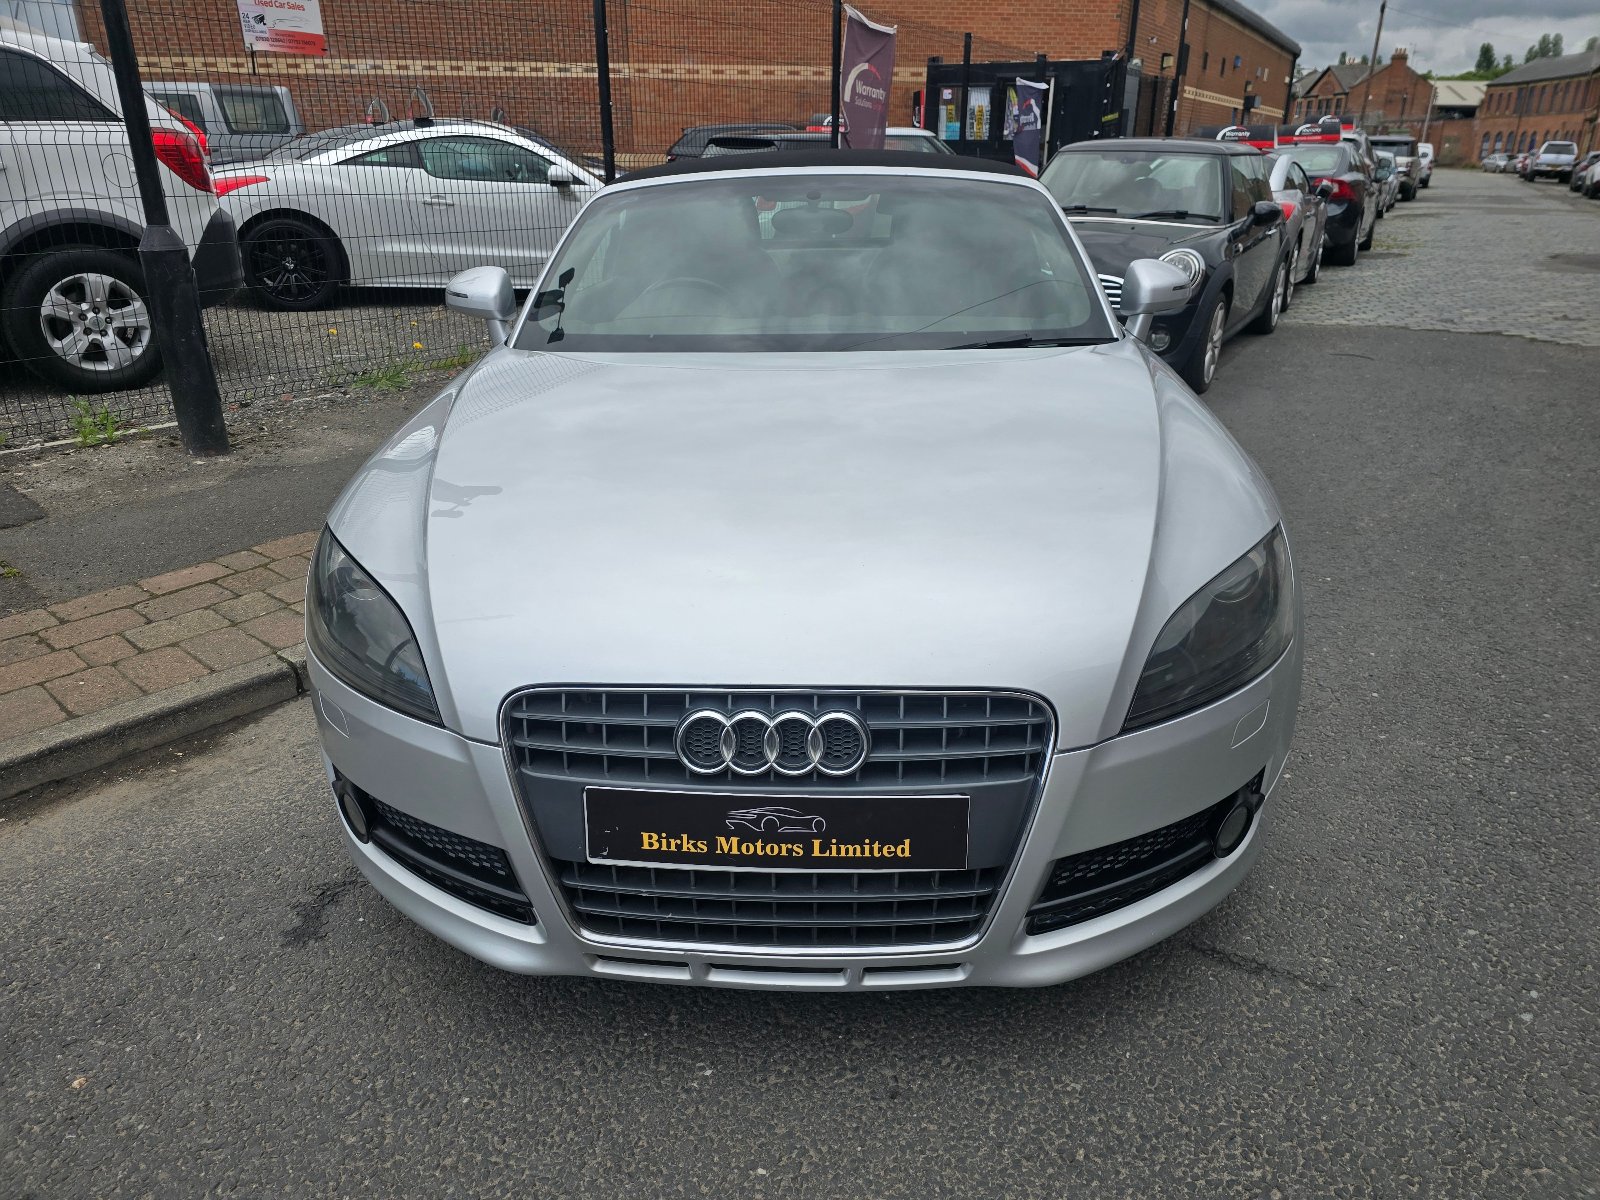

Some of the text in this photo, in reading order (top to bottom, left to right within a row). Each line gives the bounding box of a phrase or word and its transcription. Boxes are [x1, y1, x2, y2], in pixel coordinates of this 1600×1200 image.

[287, 2, 306, 11] Sales
[241, 12, 250, 20] 24
[855, 79, 887, 104] Warranty
[640, 831, 912, 858] Birks Motors Limited
